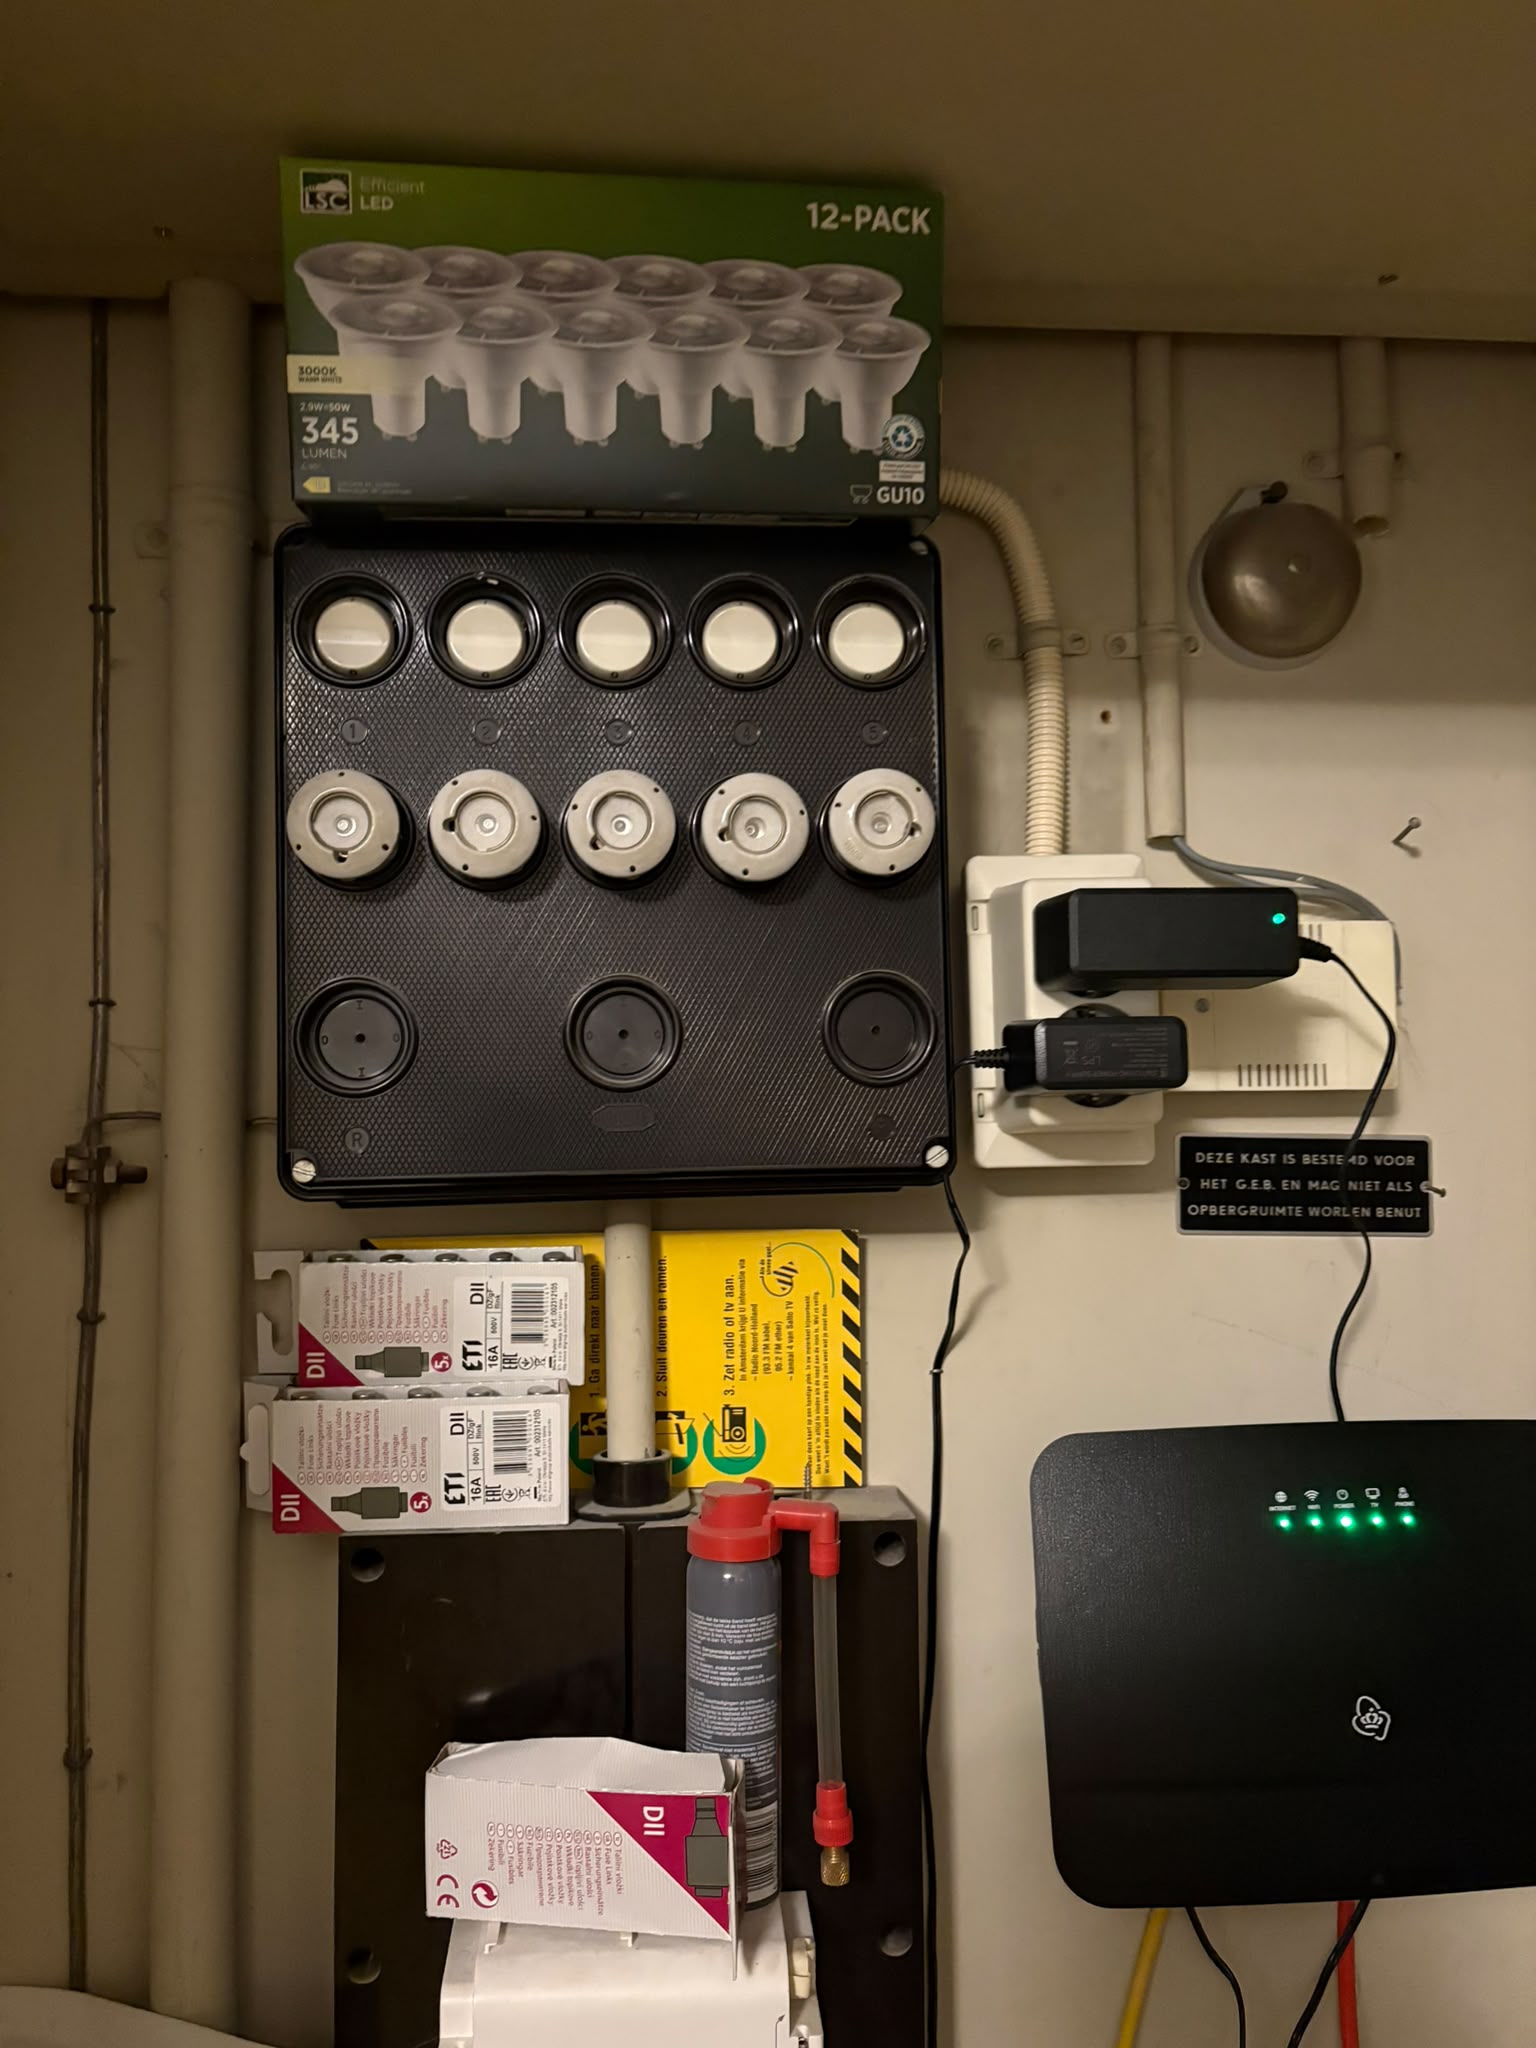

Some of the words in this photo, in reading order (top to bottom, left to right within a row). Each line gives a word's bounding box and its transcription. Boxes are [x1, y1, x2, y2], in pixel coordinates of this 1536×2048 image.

[360, 175, 425, 195] Efficient
[305, 191, 348, 210] LSC
[360, 195, 394, 210] LED
[806, 202, 931, 235] 12-PACK
[298, 365, 337, 376] 3000K
[321, 376, 343, 384] WHITE
[302, 416, 359, 445] 345
[302, 448, 348, 460] LUMEN
[876, 486, 925, 505] GU10
[1195, 1152, 1234, 1164] DEZE
[1240, 1153, 1277, 1164] KAST
[1282, 1153, 1297, 1165] IS
[1374, 1155, 1415, 1166] VOOR
[1200, 1178, 1228, 1190] HET
[1235, 1179, 1276, 1191] G.E.B.
[1282, 1179, 1301, 1191] EN
[1307, 1180, 1340, 1191] MAG
[1347, 1180, 1381, 1192] NIET
[1386, 1181, 1413, 1192] ALS
[1187, 1204, 1304, 1217] OPBERGRUIMTE
[1375, 1207, 1421, 1218] BENUT
[656, 1255, 667, 1293] ramen.
[738, 1259, 746, 1270] via
[589, 1262, 600, 1300] binnen.
[724, 1274, 735, 1298] aan.
[738, 1271, 747, 1305] informatie
[470, 1283, 484, 1305] DII
[658, 1298, 667, 1310] en
[723, 1302, 735, 1312] tv
[785, 1300, 794, 1310] TV
[590, 1305, 600, 1329] naar
[723, 1316, 735, 1327] of
[739, 1314, 749, 1332] krijgt
[785, 1311, 794, 1329] Salto
[656, 1315, 667, 1352] deuren
[750, 1303, 759, 1353] Noord-Holland
[774, 1321, 783, 1342] ether)
[462, 1340, 483, 1371] ETI
[589, 1333, 600, 1364] direkt
[723, 1331, 735, 1360] radio
[739, 1333, 747, 1373] Amsterdam
[762, 1343, 770, 1355] FM
[775, 1343, 783, 1355] FM
[306, 1352, 326, 1379] DII
[434, 1355, 450, 1369] 5x
[488, 1345, 499, 1368] 16A
[750, 1354, 759, 1375] Radio
[786, 1351, 794, 1374] kanaal
[589, 1369, 600, 1383] Ga
[656, 1357, 667, 1382] Sluit
[723, 1364, 735, 1381] Zet
[739, 1373, 747, 1381] In
[589, 1388, 600, 1398] 1.
[656, 1386, 667, 1397] 2.
[723, 1385, 735, 1396] 3.
[449, 1412, 465, 1436] DII
[420, 1437, 428, 1468] Zekering
[444, 1473, 466, 1505] ETI
[470, 1477, 482, 1500] 16A
[280, 1494, 300, 1522] DII
[413, 1495, 429, 1510] 5x
[642, 1805, 666, 1836] DII
[488, 1838, 496, 1871] Zekering
[436, 1874, 460, 1908] CE
